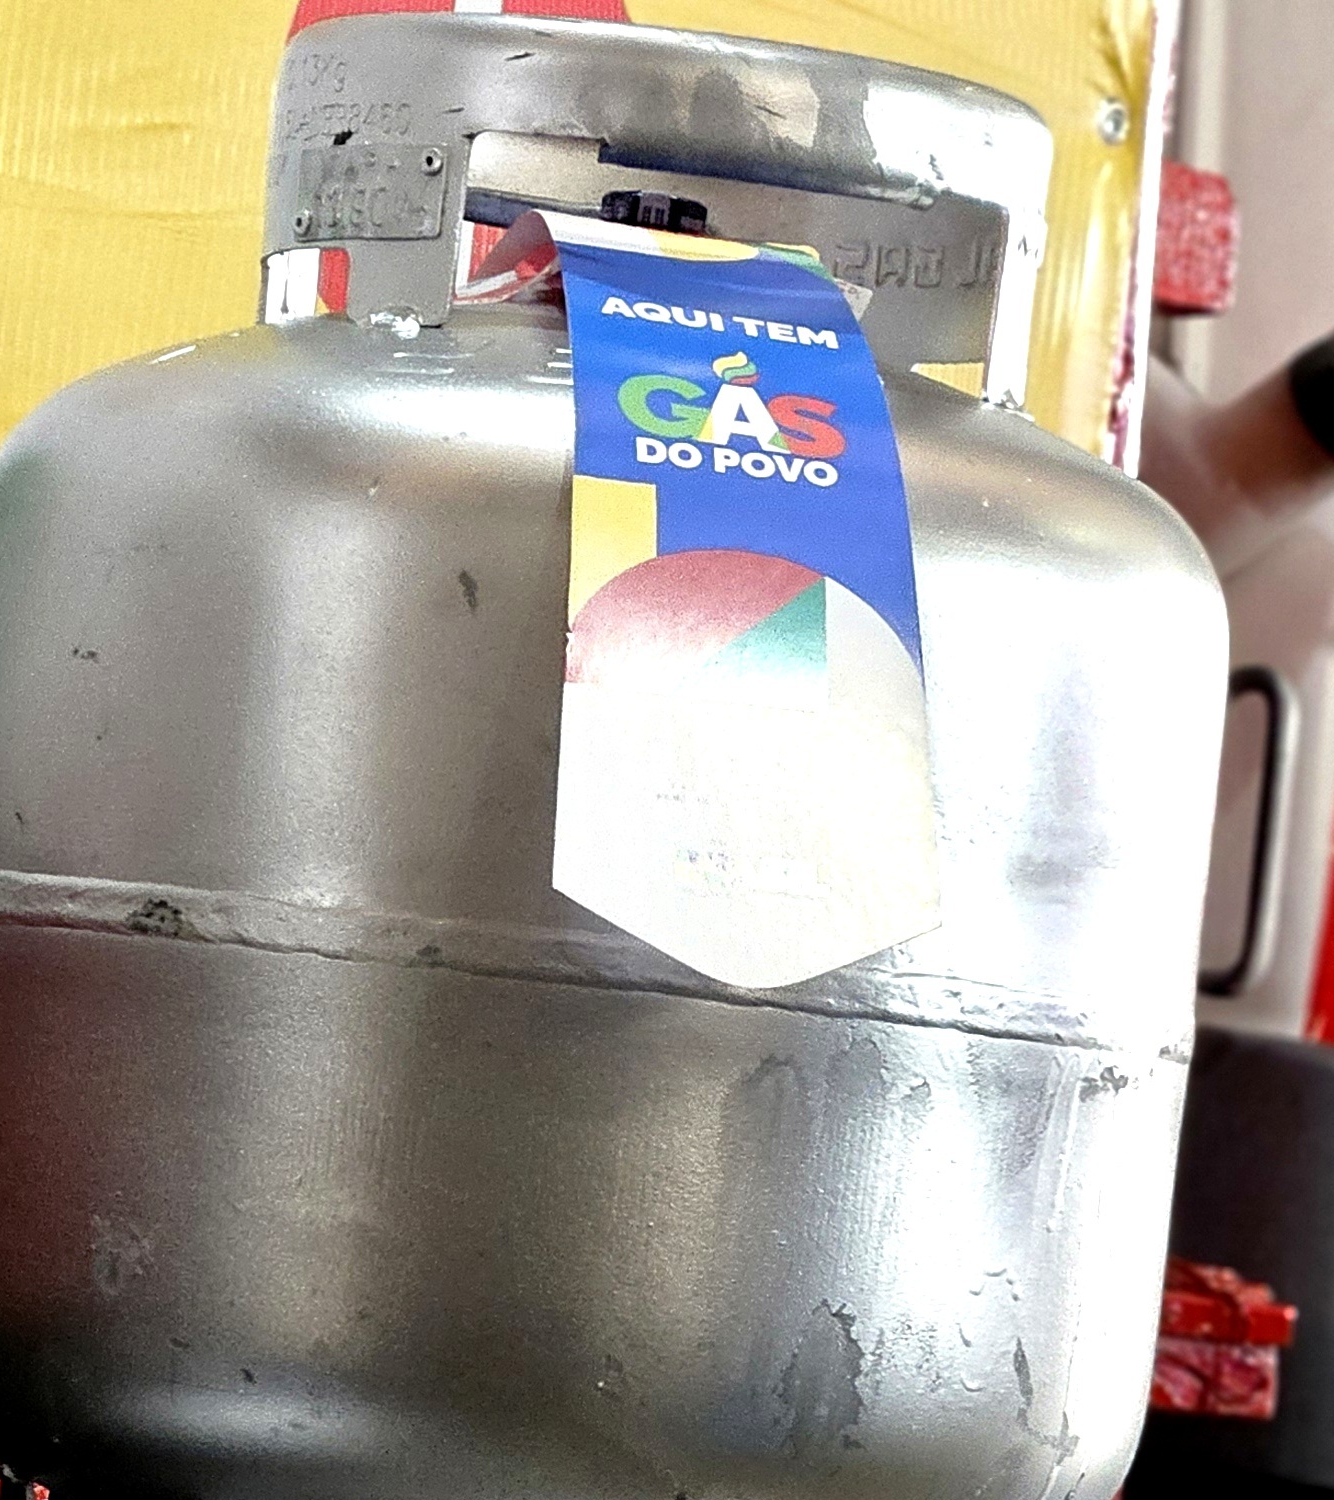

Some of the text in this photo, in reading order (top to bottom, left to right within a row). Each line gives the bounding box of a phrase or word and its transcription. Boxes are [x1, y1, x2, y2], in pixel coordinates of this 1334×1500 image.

[601, 297, 839, 349] AQUI TEM
[636, 437, 838, 487] DO POVO
